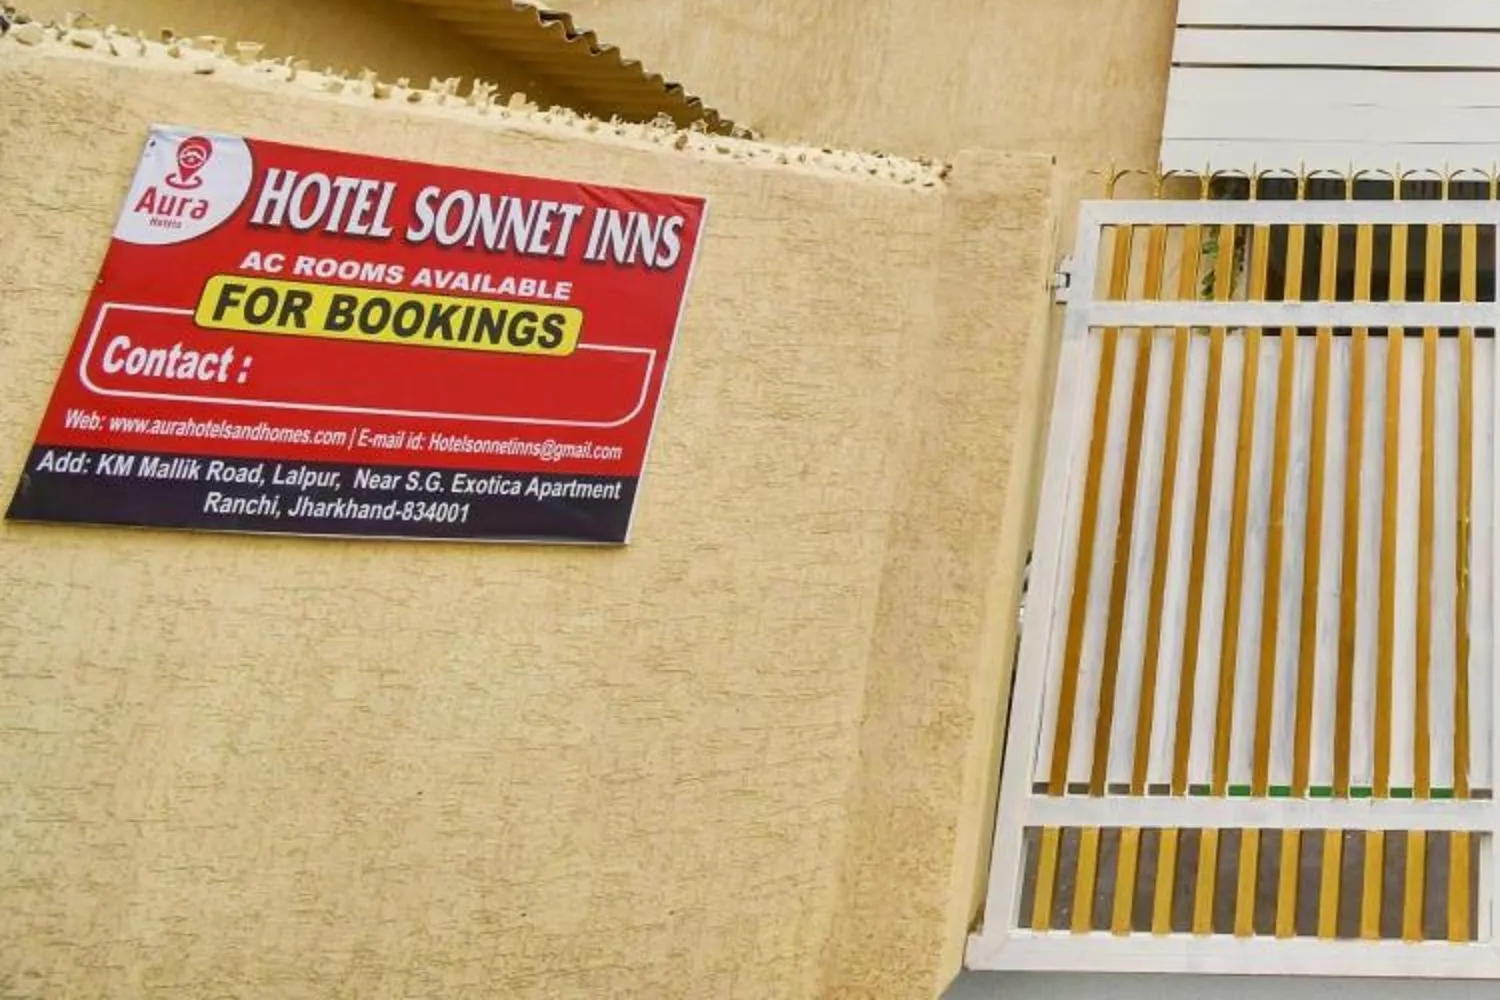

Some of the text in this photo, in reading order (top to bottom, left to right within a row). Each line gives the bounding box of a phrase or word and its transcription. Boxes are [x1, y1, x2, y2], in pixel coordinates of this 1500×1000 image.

[134, 186, 210, 220] Aura
[250, 167, 685, 268] HOTEL SONNET INNS
[240, 250, 573, 301] AC ROOMS AVAILABLE
[212, 283, 566, 350] FOR BOOKINGS
[64, 408, 105, 432] Web:
[109, 415, 347, 447] www.aurahotelsandhomes.com
[357, 428, 405, 450] E-mail
[406, 431, 425, 451] id:
[429, 433, 624, 462] Hotelsonnetinns@gmail.com
[35, 449, 622, 501] Add: KM Mallik Road, Lalpur, Near S.G. Exotica Apartment
[203, 491, 471, 524] Ranchi, Jharkhand-834001
